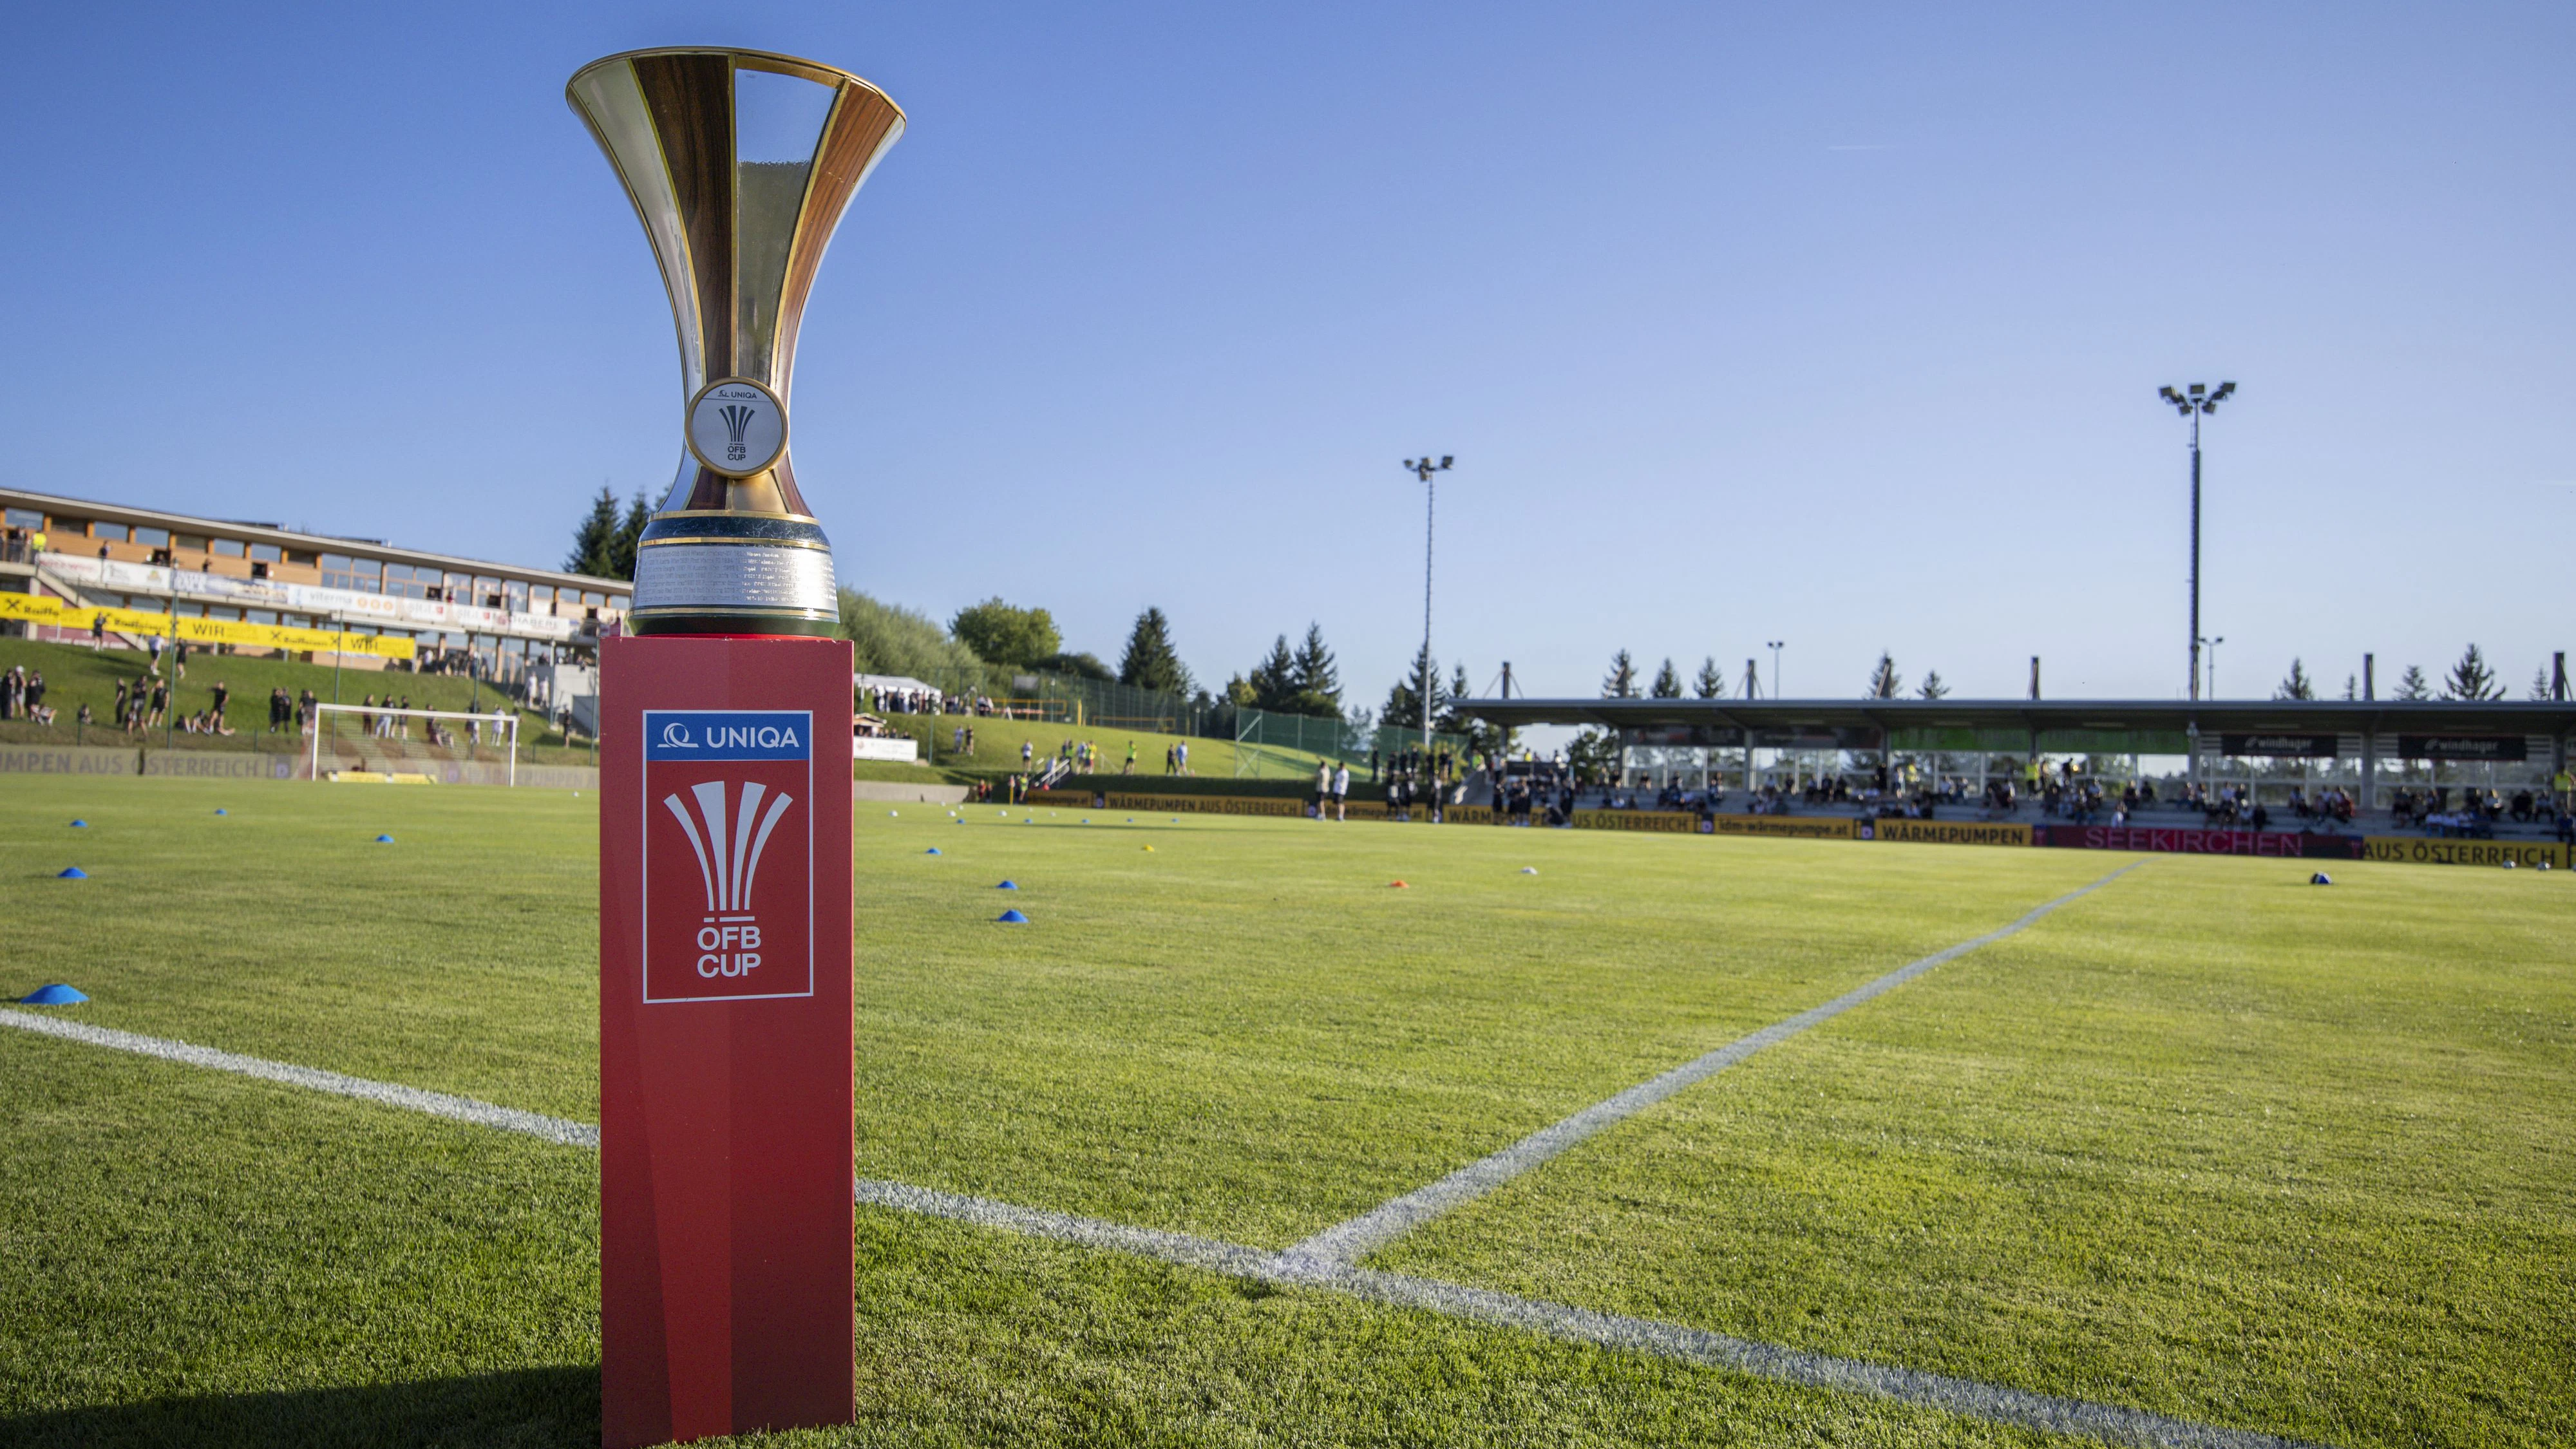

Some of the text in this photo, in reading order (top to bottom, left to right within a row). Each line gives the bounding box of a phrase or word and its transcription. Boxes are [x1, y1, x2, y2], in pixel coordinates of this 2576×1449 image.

[706, 726, 800, 748] UNIQA
[79, 754, 123, 773] AUS
[1109, 794, 1196, 813] WÄRMEPUMPEN
[1199, 799, 1222, 813] AUS
[1595, 812, 1689, 833] ÖSTERREICH
[1882, 823, 2024, 844] WÄRMEPUMPEN
[2085, 826, 2303, 857] SEEKIRCHEN
[2364, 840, 2556, 867] AUS ÖSTERREICH
[697, 952, 761, 978] CUP
